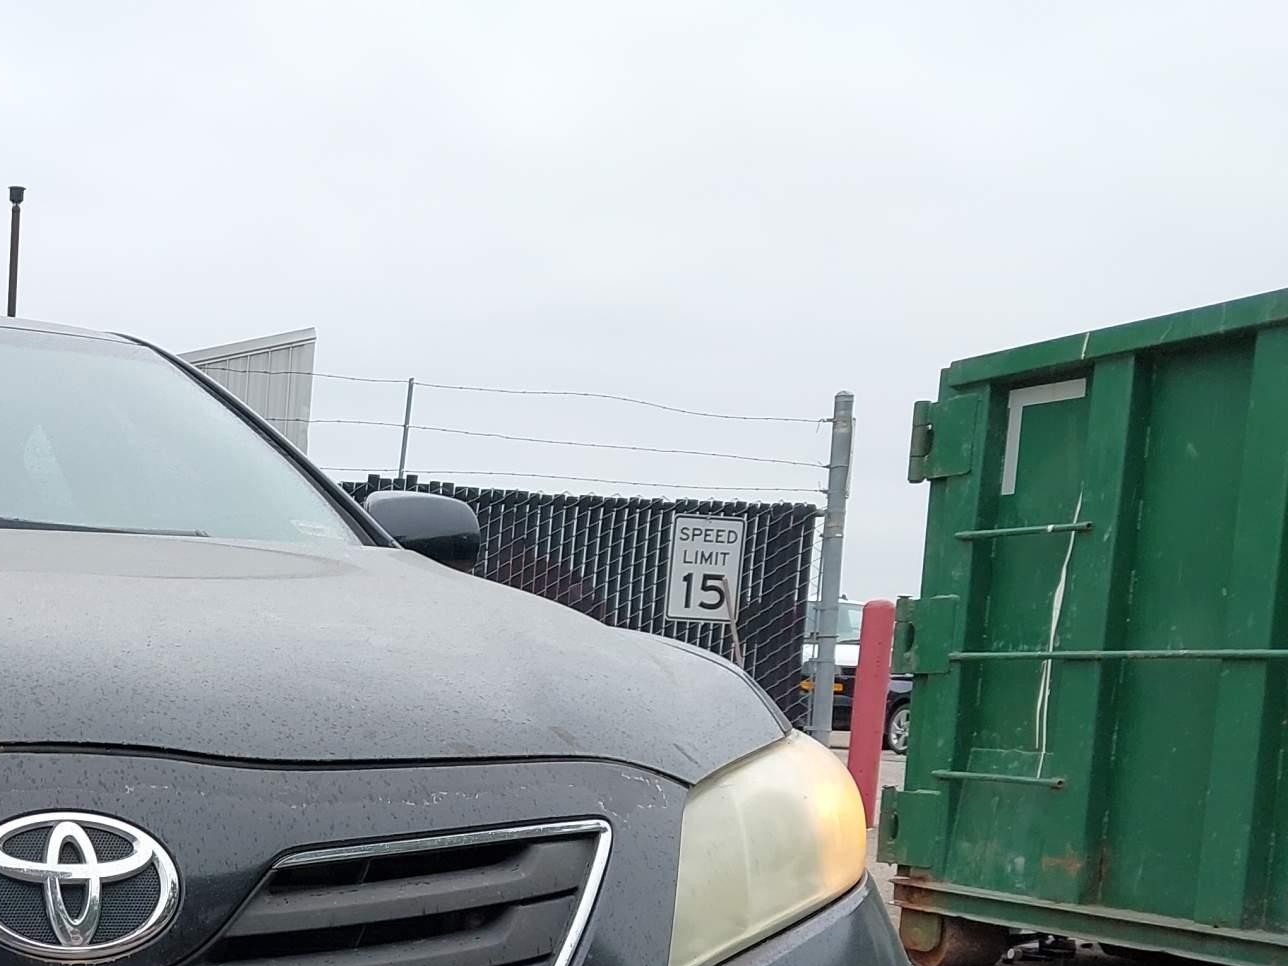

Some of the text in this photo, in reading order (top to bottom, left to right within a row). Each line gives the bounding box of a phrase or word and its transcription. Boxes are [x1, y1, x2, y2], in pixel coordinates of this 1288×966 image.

[679, 527, 738, 544] SPEED
[682, 549, 730, 566] LIMIT
[682, 572, 726, 610] 15
